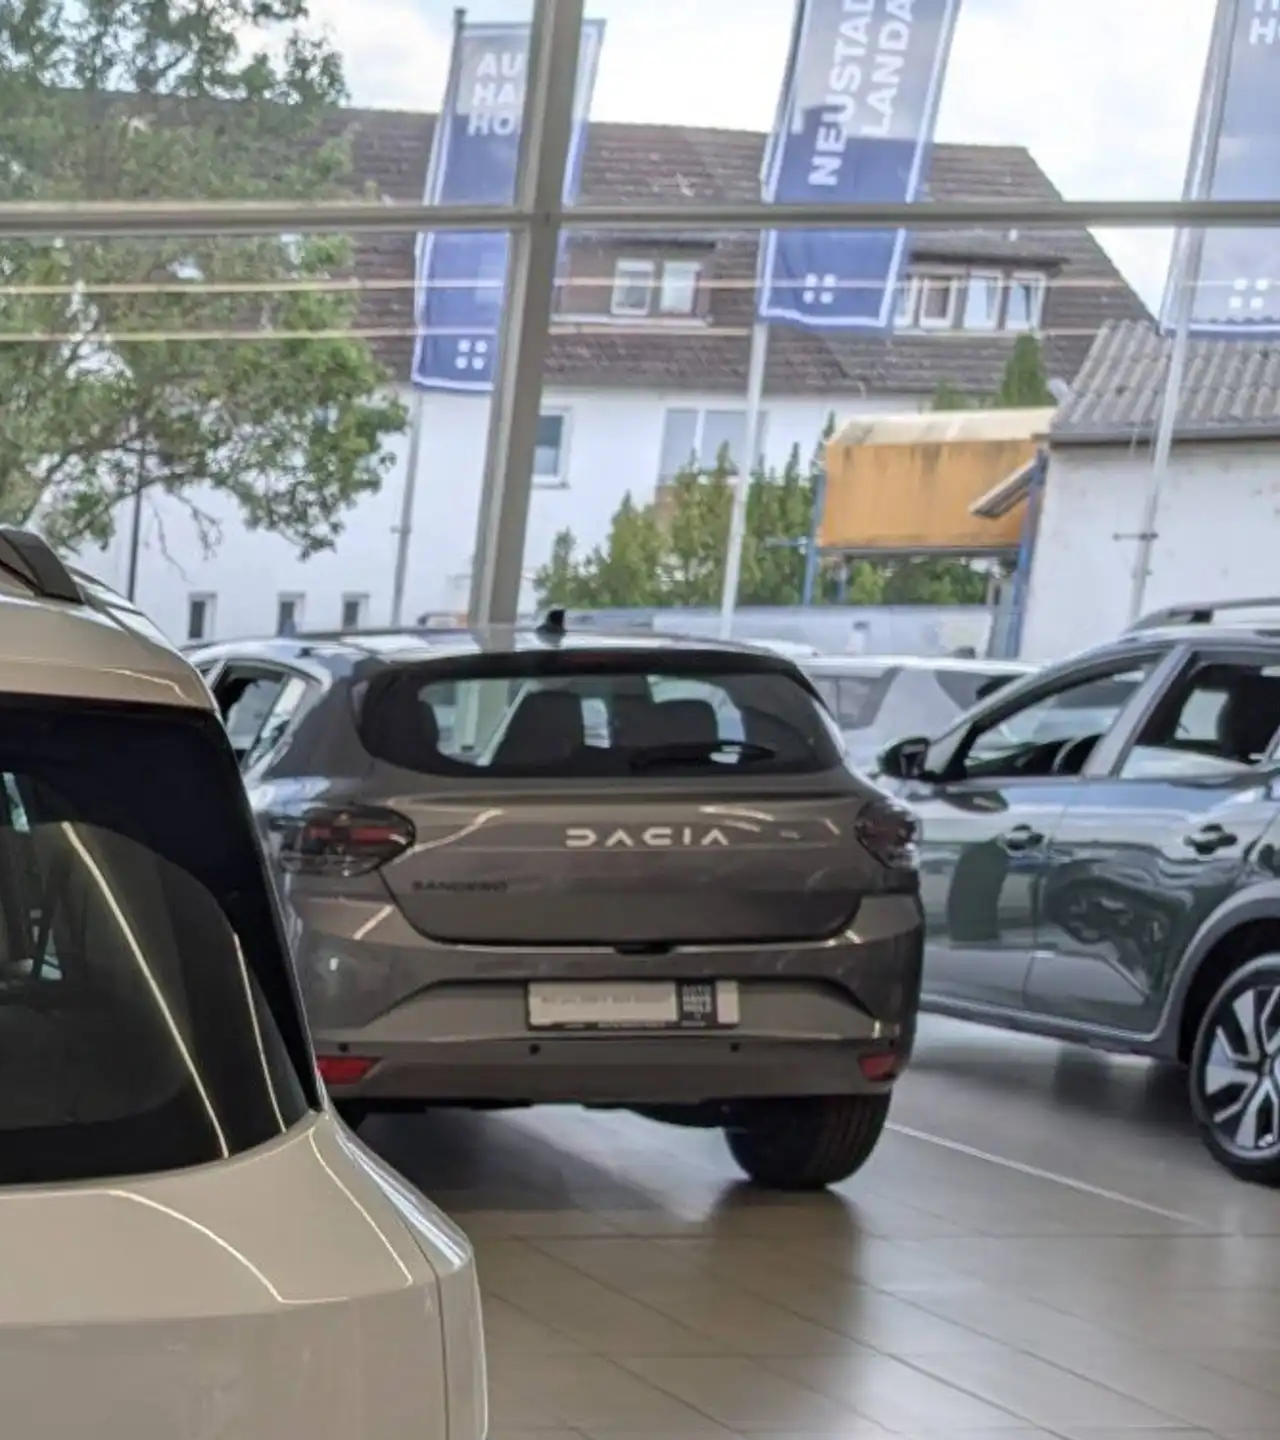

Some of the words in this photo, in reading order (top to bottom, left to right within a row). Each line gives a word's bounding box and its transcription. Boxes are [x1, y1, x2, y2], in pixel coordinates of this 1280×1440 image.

[476, 52, 524, 78] AU
[860, 0, 915, 136] LANDA
[472, 82, 517, 107] HA
[808, 0, 875, 186] NEUSTA
[467, 111, 516, 137] HO
[565, 826, 729, 847] DACIA
